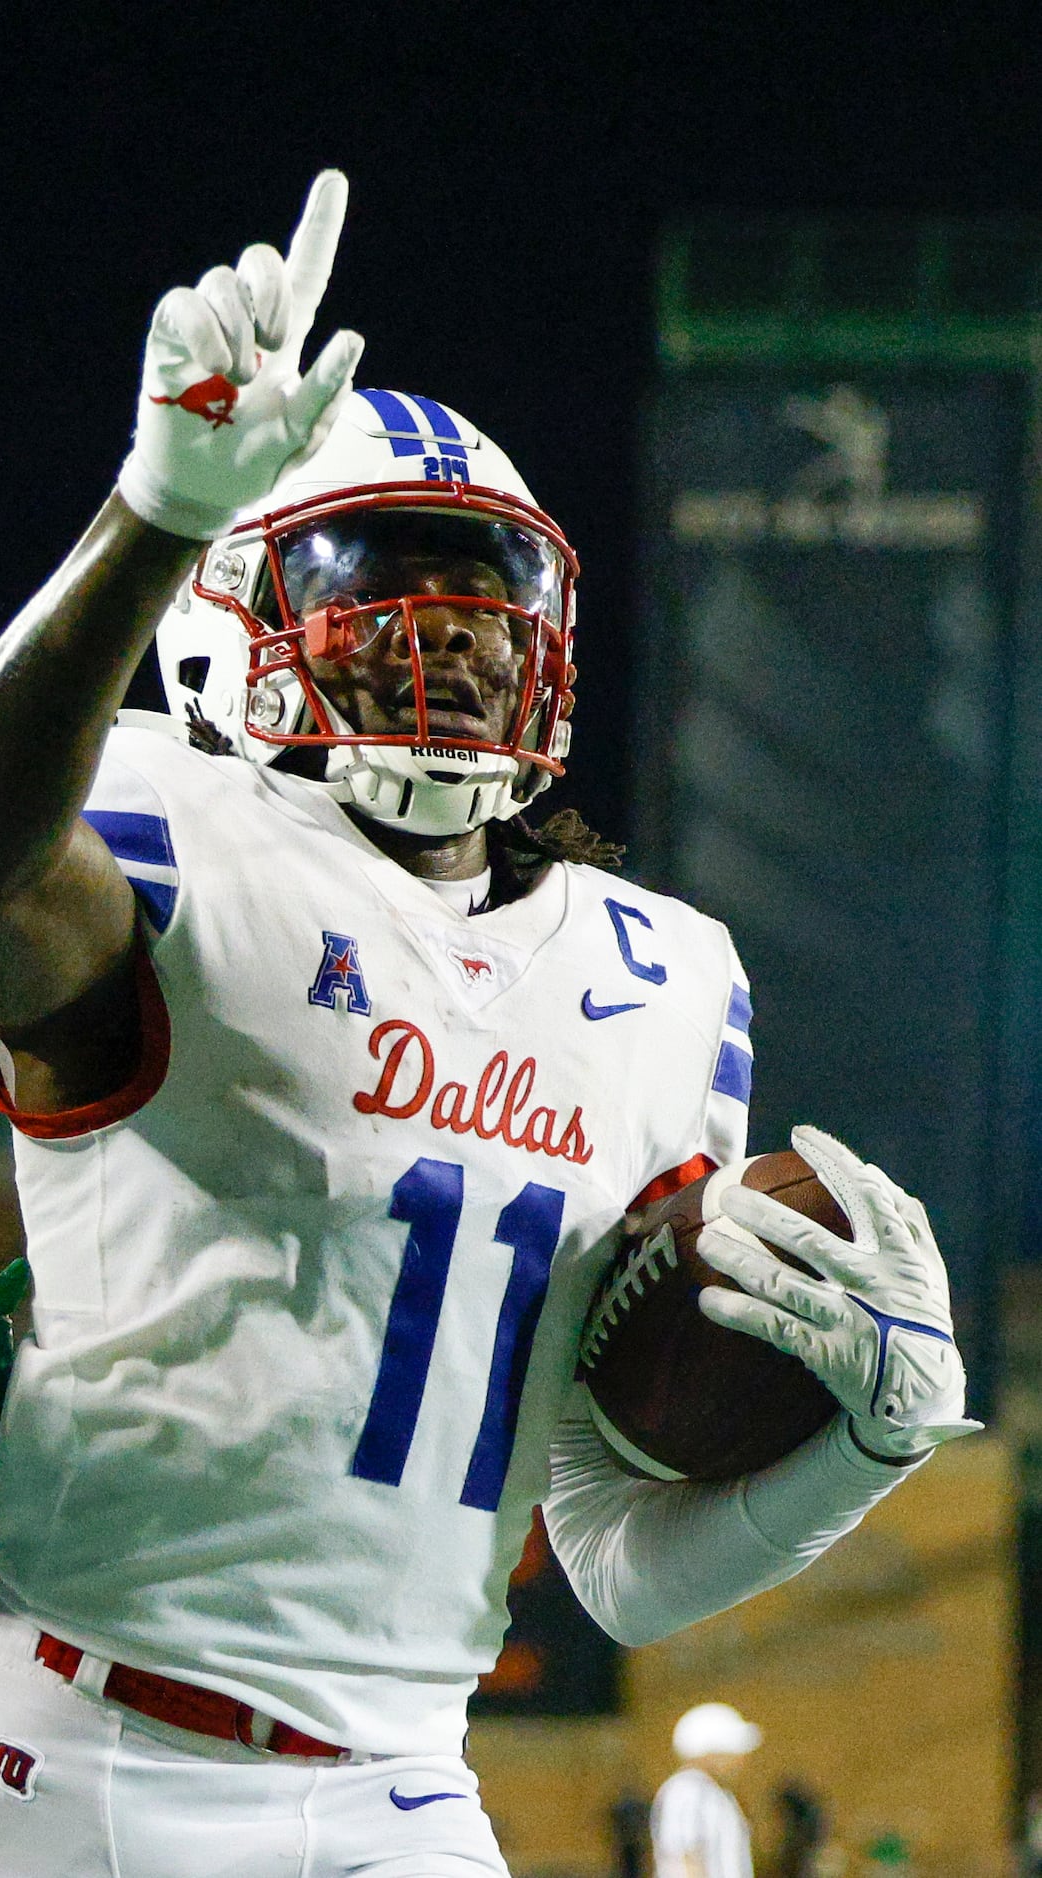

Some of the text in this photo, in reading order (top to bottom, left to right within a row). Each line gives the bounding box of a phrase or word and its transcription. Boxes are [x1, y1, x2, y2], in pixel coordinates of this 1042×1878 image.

[423, 456, 470, 485] 214
[308, 930, 372, 1017] A
[603, 897, 668, 986] C
[352, 1018, 594, 1165] Dallas
[351, 1156, 566, 1513] 11
